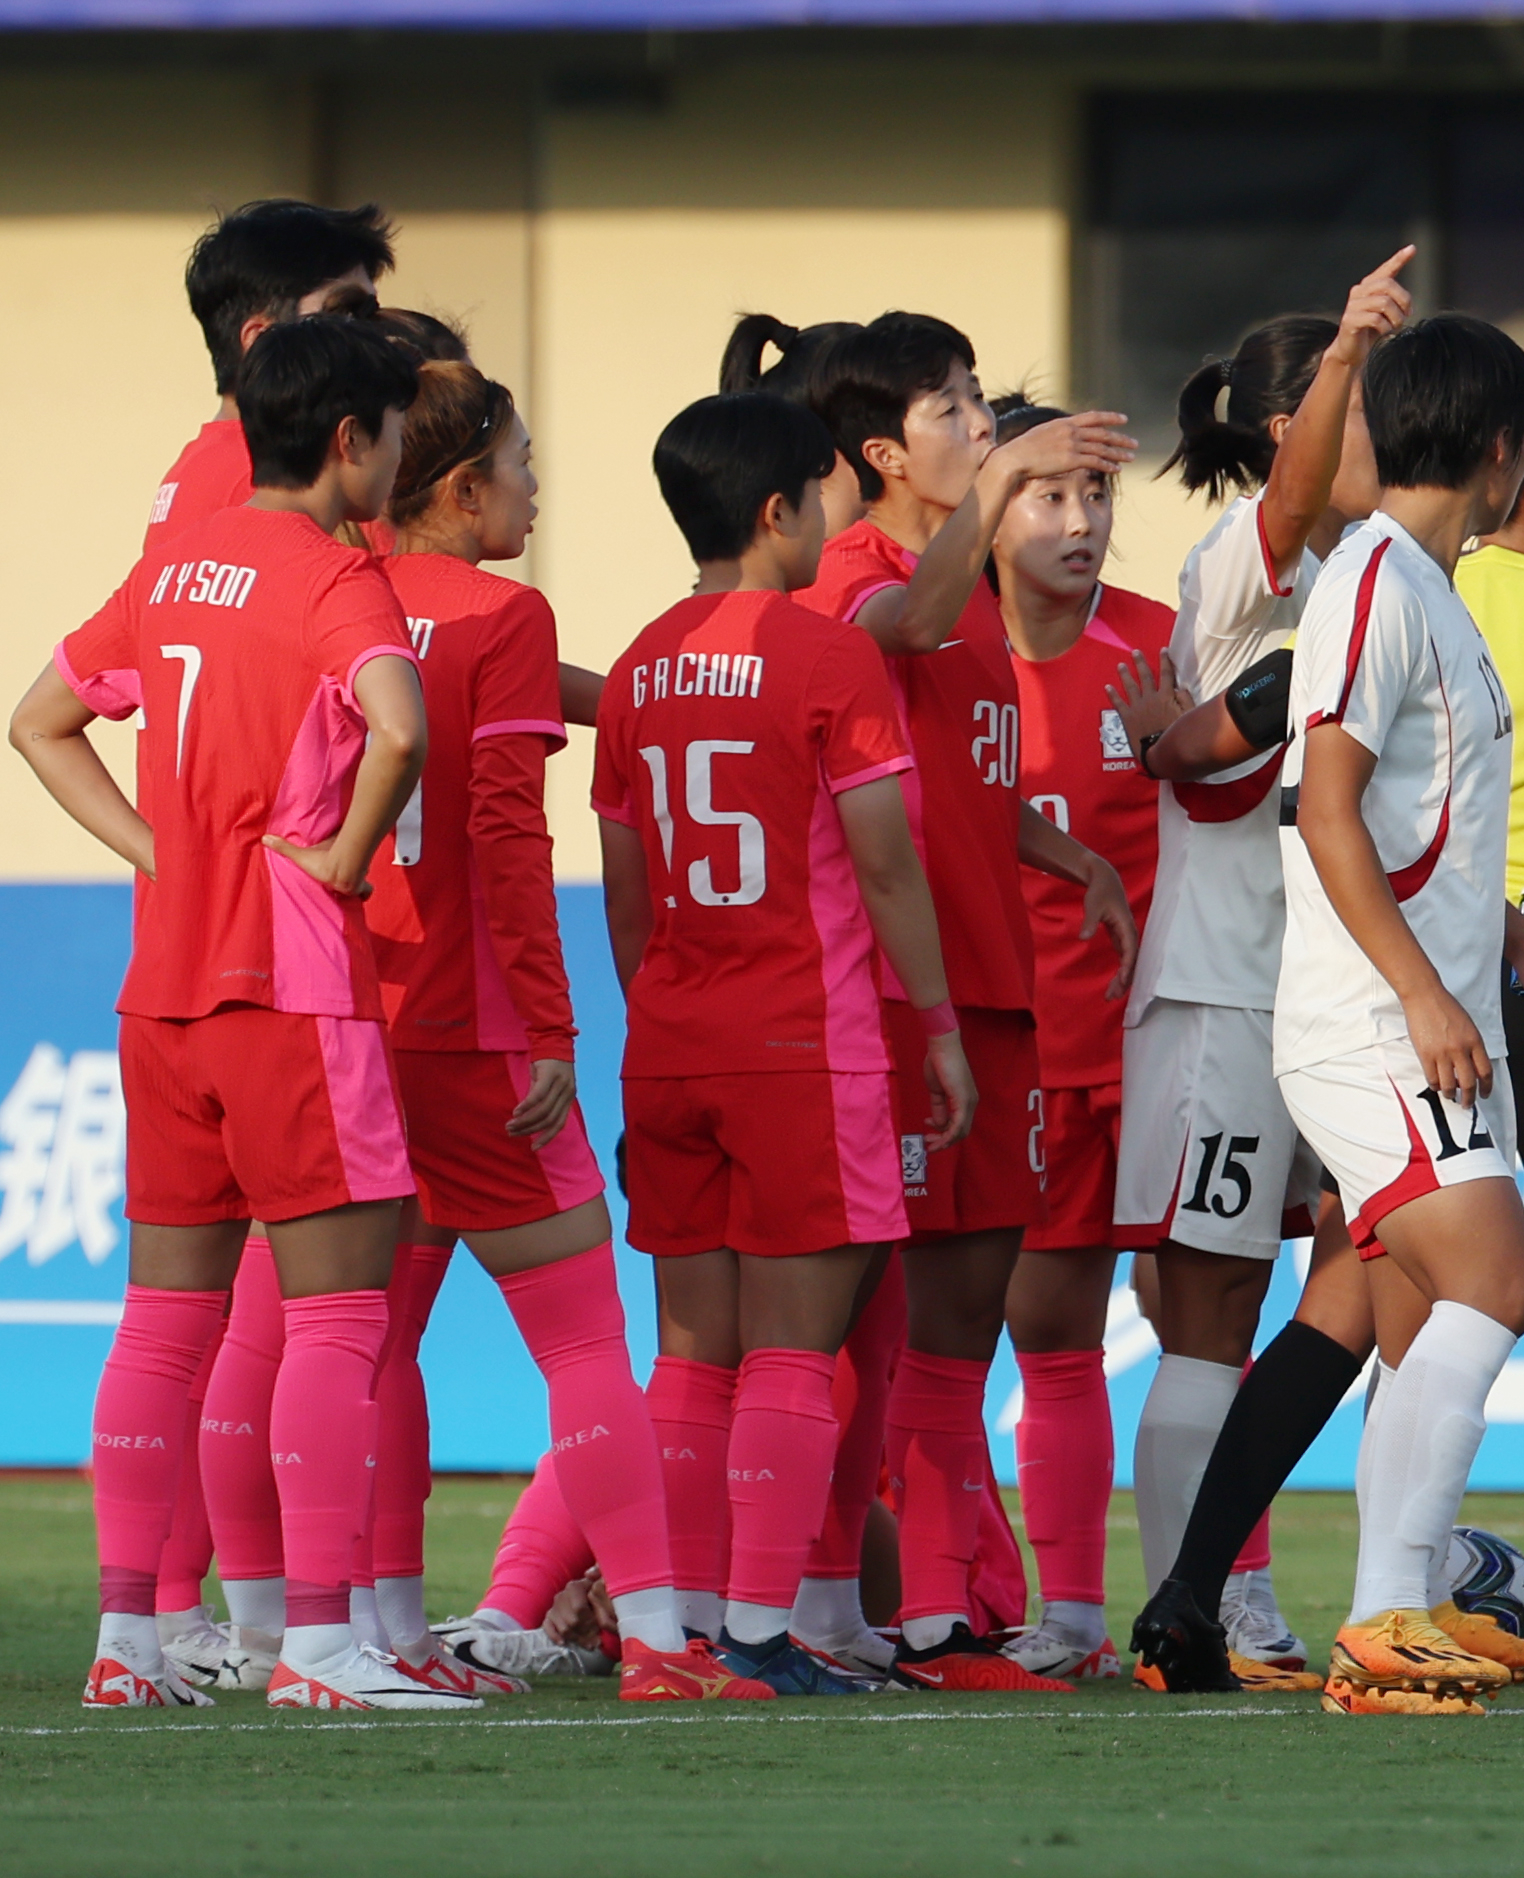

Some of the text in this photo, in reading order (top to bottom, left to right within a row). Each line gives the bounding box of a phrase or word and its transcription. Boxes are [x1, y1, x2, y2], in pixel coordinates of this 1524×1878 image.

[160, 644, 203, 779] 7
[971, 699, 1019, 788] 20
[1102, 760, 1136, 772] KOREA
[638, 739, 766, 908] 15
[1181, 1131, 1260, 1218] 15
